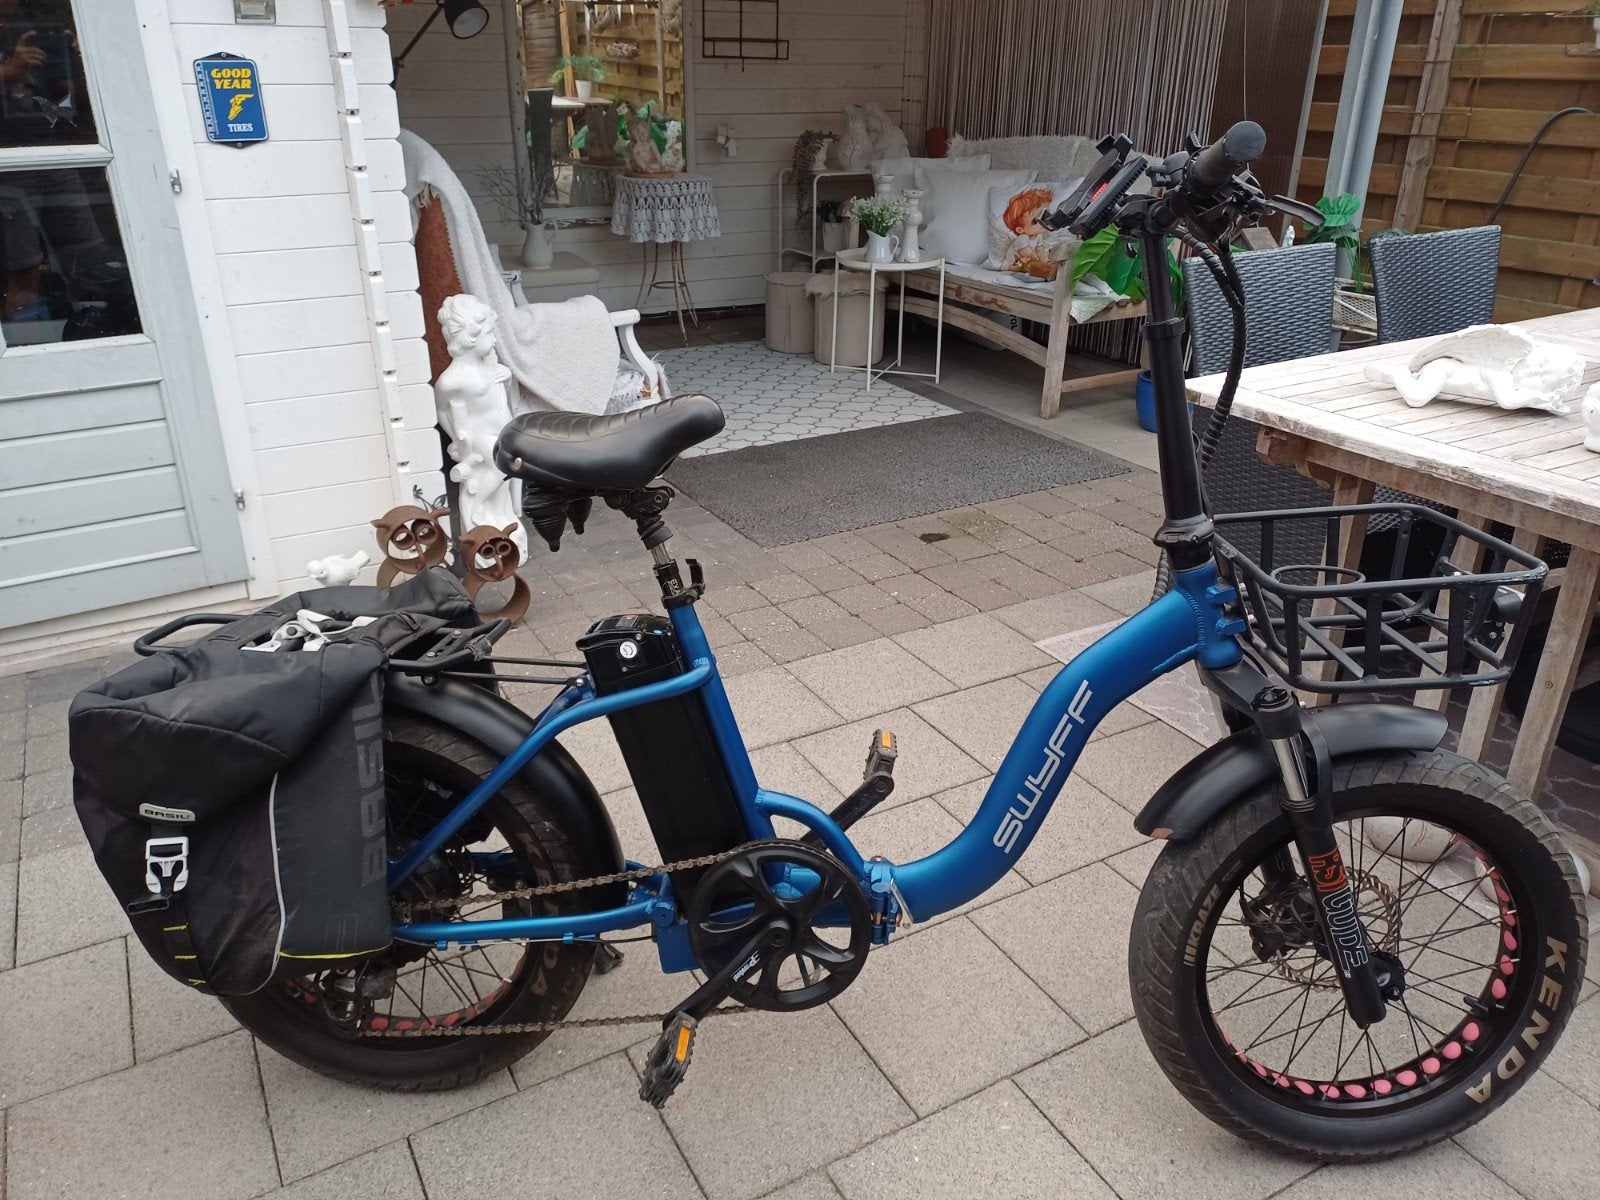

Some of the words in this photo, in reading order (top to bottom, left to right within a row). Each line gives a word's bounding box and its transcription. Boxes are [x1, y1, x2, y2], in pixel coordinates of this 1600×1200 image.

[211, 68, 251, 78] GOOD
[214, 79, 251, 89] YEAR
[228, 123, 253, 132] TIRES
[144, 809, 190, 819] BASIL
[1465, 935, 1568, 1104] KENDA
